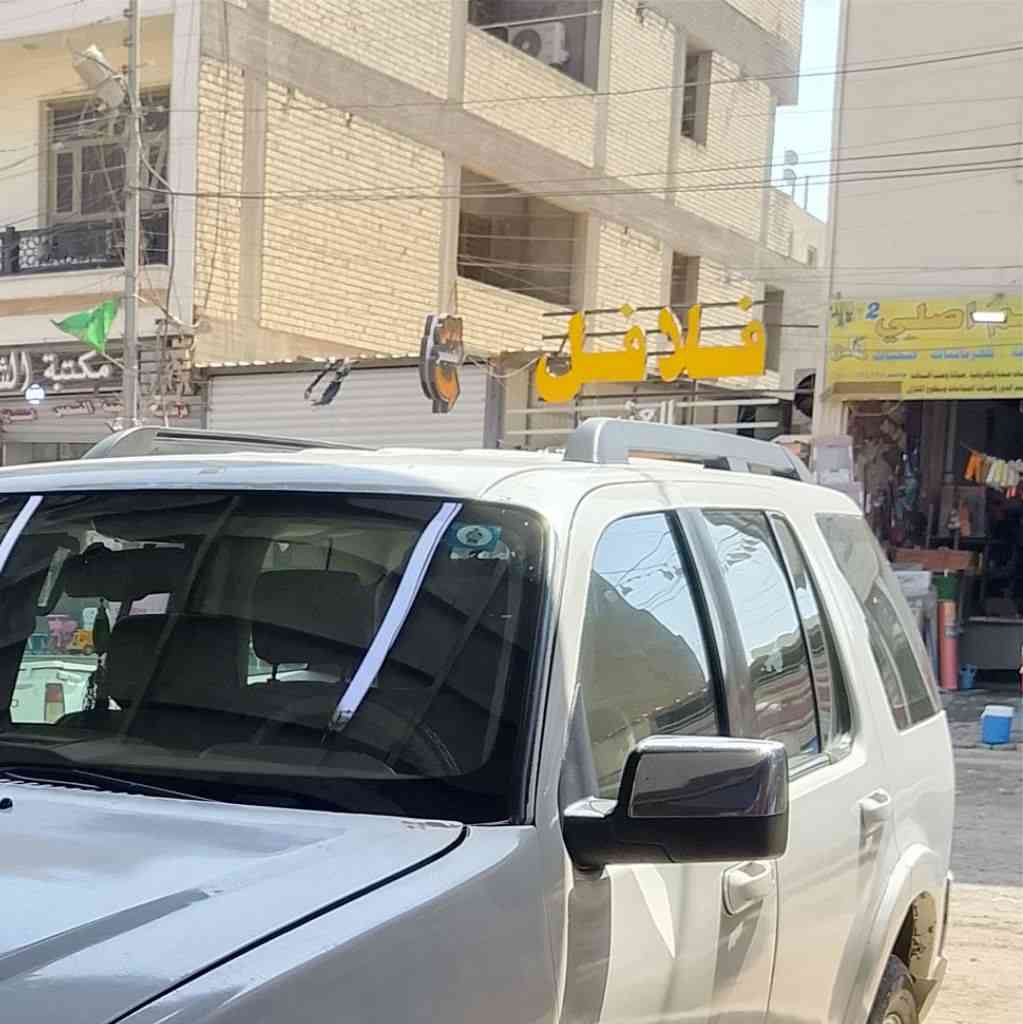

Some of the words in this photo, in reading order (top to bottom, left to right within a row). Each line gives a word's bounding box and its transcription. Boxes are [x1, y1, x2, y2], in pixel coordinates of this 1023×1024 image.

[865, 302, 880, 320] 2
[42, 350, 111, 392] مكتبة
[535, 296, 766, 404] فلافل
